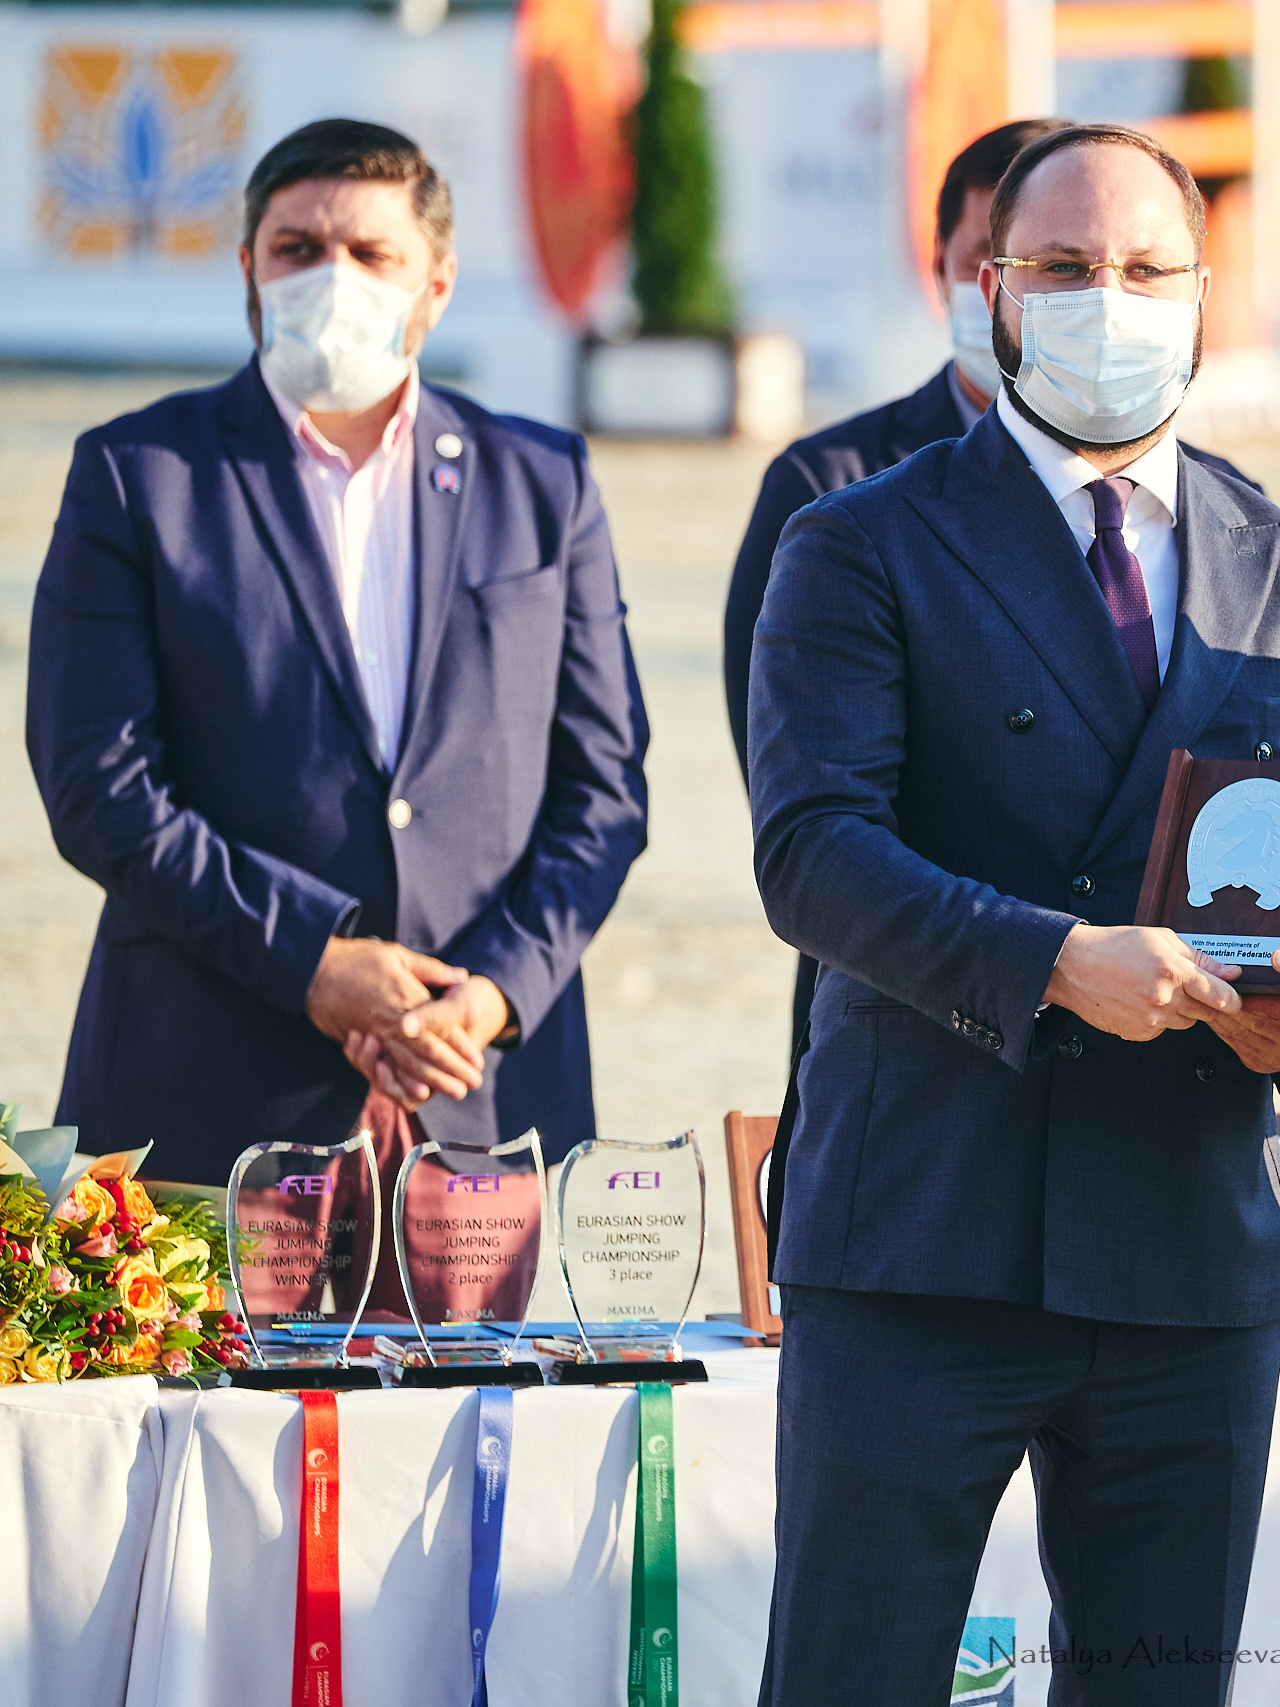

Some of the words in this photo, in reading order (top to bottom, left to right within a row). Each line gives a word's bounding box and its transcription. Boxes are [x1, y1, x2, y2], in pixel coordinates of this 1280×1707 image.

[1216, 941, 1252, 949] compliments
[1237, 950, 1272, 959] Federatio
[248, 1219, 314, 1232] EURASIAN
[317, 1219, 358, 1232] SHOW
[416, 1218, 482, 1231] EURASIAN
[486, 1218, 526, 1230] SHOW
[577, 1215, 642, 1228] EURASIAN
[646, 1215, 686, 1227] SHOW
[273, 1238, 333, 1251] JUMPING
[442, 1236, 500, 1249] JUMPING
[602, 1233, 661, 1245] JUMPING
[253, 1255, 352, 1269] CHAMPIONSHIP
[422, 1254, 520, 1267] CHAMPIONSHIP
[582, 1250, 680, 1263] CHAMPIONSHIP
[275, 1274, 329, 1286] WINNER
[448, 1272, 455, 1284] 2
[459, 1271, 493, 1286] place
[609, 1268, 616, 1281] 3
[619, 1268, 653, 1282] place
[276, 1311, 326, 1322] MAXIMA
[445, 1309, 495, 1319] MAXIMA
[607, 1305, 655, 1316] MAXIMA
